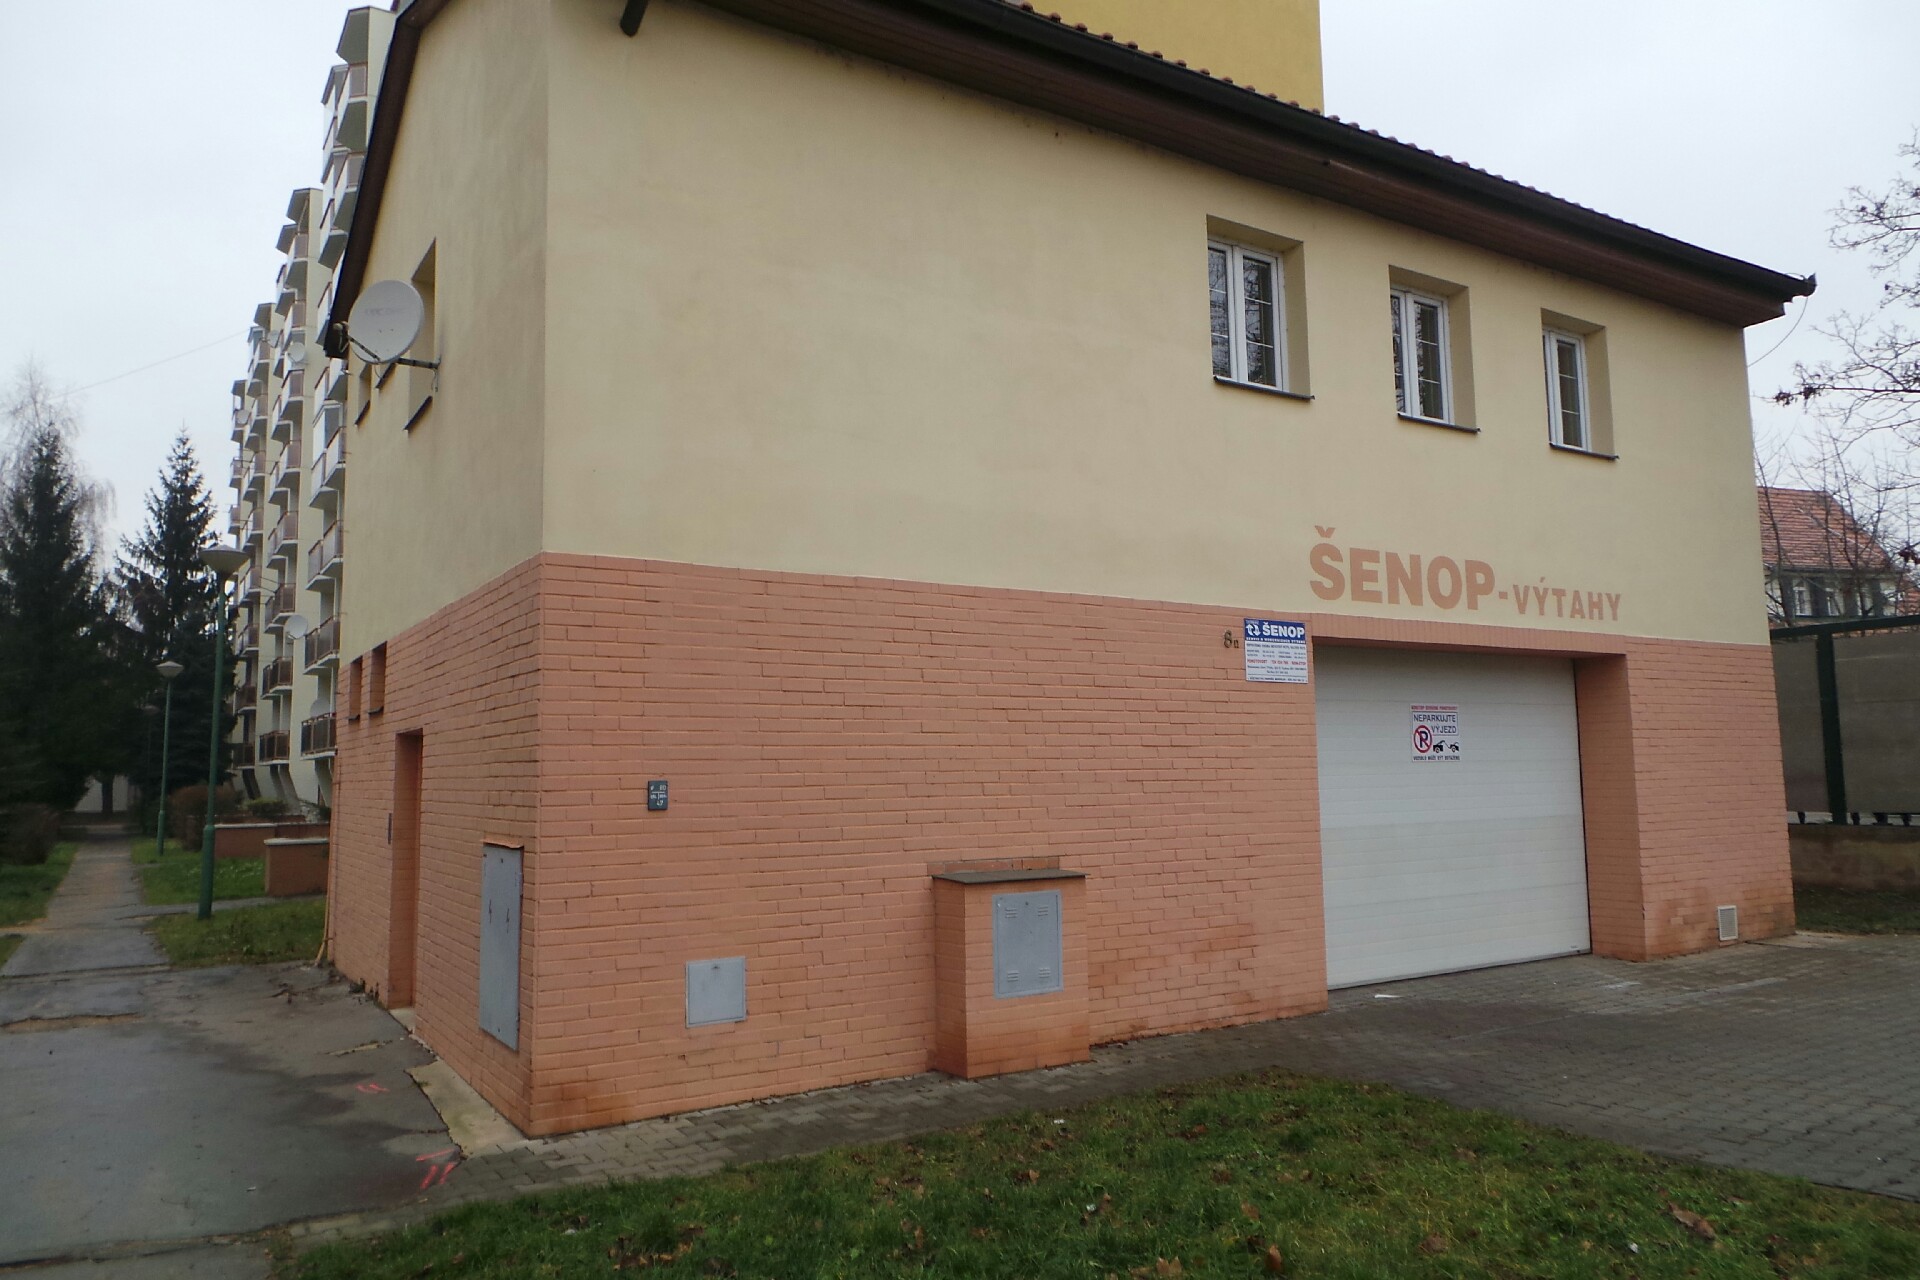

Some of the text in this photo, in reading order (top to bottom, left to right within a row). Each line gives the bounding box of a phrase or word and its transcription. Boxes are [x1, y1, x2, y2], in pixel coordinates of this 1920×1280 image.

[1262, 621, 1305, 638] ŠENOP
[1413, 714, 1456, 723] NEPARKUJTE
[1431, 723, 1457, 733] VÝJEZD
